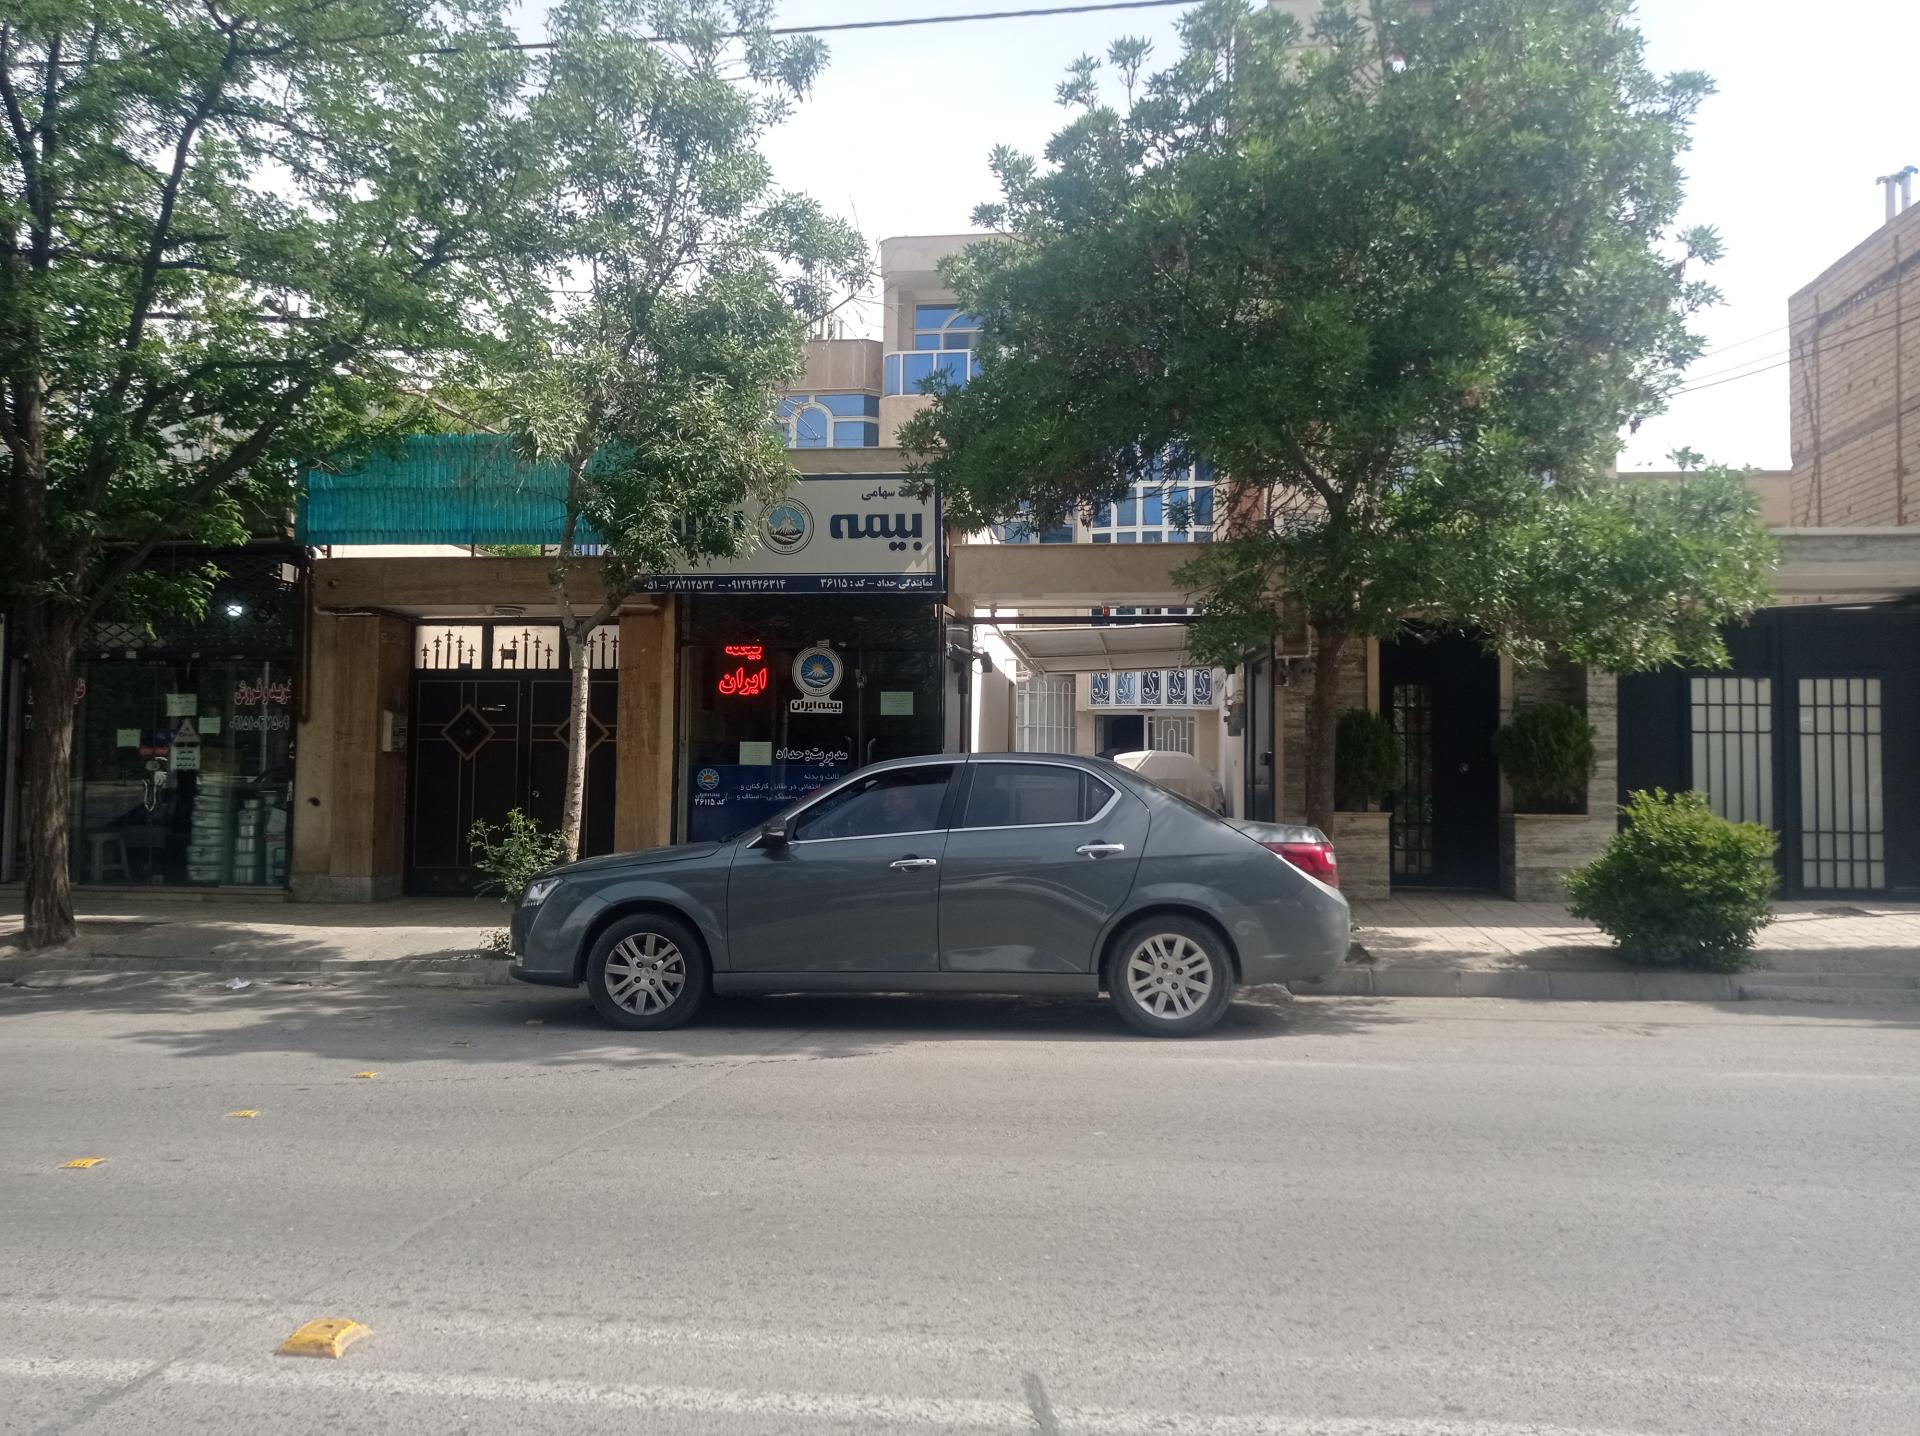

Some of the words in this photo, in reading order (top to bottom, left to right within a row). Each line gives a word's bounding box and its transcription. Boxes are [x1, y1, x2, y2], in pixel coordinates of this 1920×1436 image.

[861, 485, 896, 501] سهامی
[829, 513, 923, 552] بیمه
[820, 578, 848, 589] ۳۶۱۱۵
[877, 578, 897, 587] حداد
[898, 578, 933, 589] نمایندگی
[718, 666, 768, 696] ایران
[791, 700, 817, 713] ایران
[817, 702, 842, 713] بیمه
[775, 747, 805, 760] حداد
[694, 798, 715, 806] ۳۶۱۱۵
